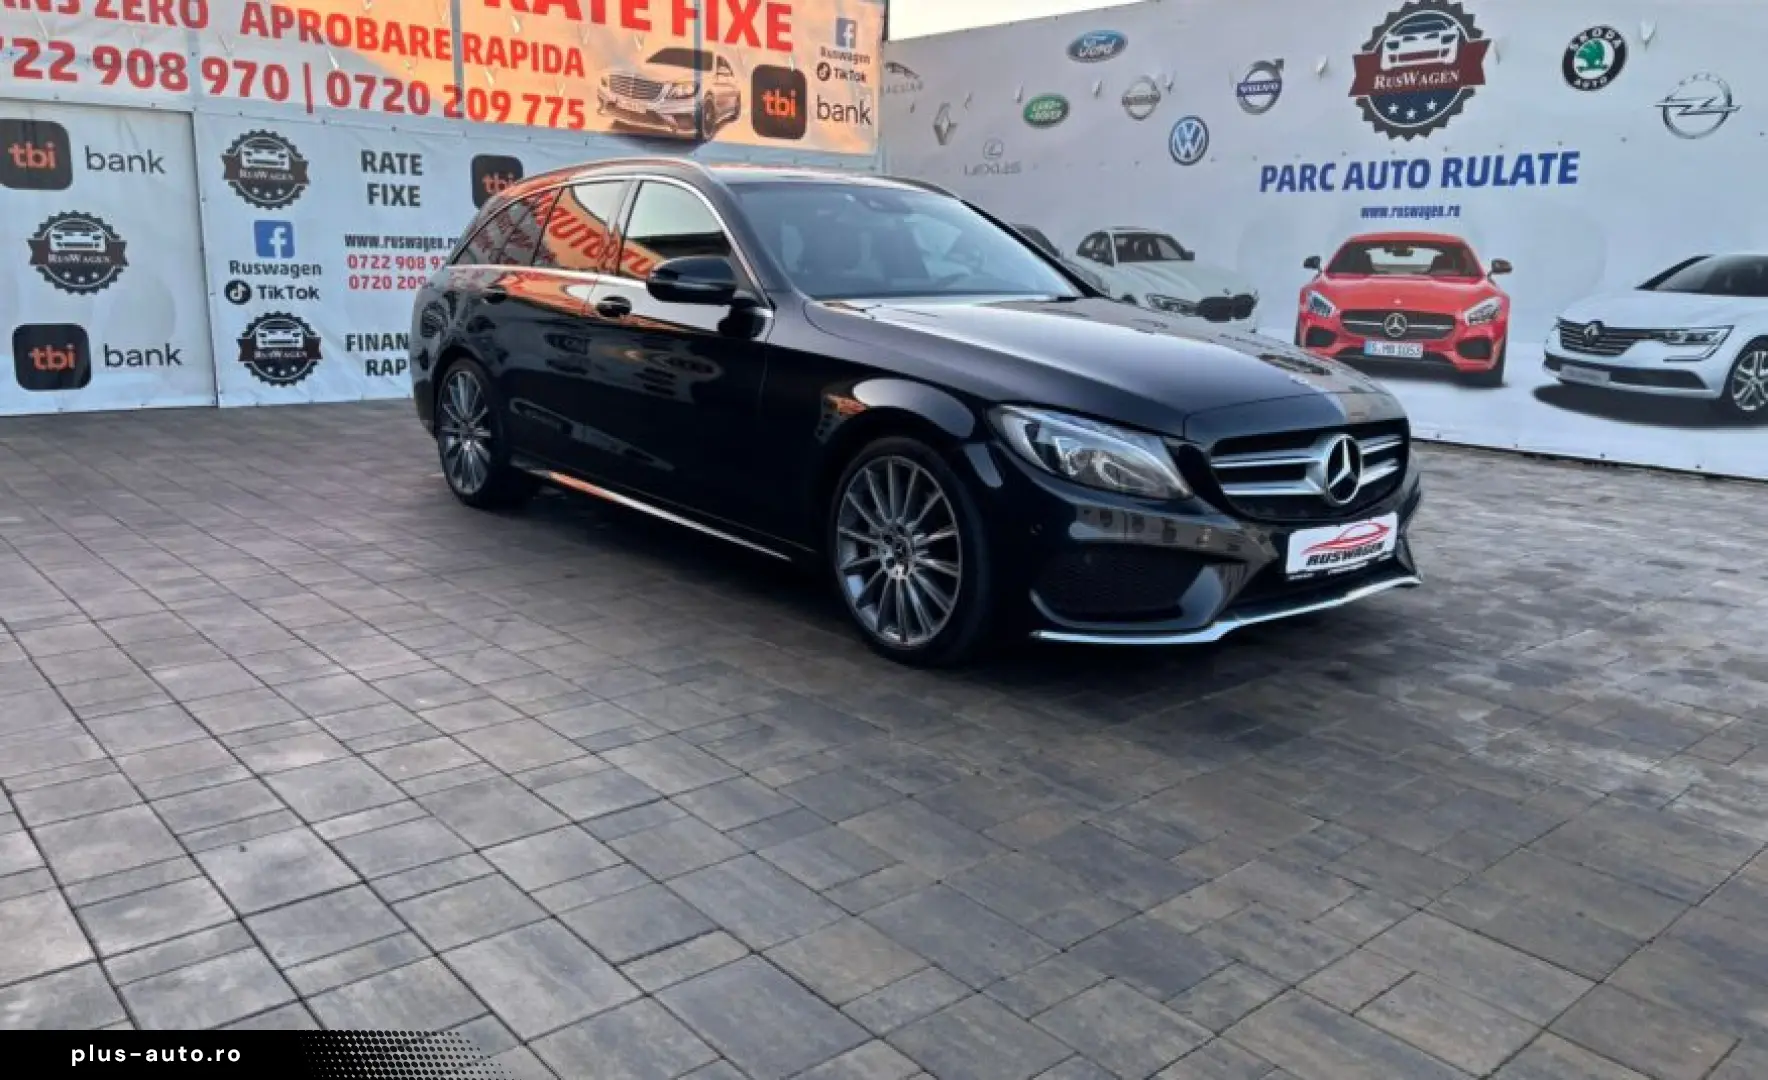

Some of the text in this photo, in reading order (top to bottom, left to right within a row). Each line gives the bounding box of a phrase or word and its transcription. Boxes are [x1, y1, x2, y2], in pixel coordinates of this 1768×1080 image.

[671, 0, 794, 52] FIXE
[240, 2, 452, 61] APROBARE
[462, 32, 586, 78] RAPIDA
[0, 36, 78, 82] 22
[92, 44, 189, 92] 908
[201, 56, 290, 102] 970
[326, 69, 430, 117] 0720
[443, 83, 511, 124] 209
[522, 92, 586, 131] 775
[833, 67, 867, 84] TikTok
[762, 88, 873, 126] tbi bank
[8, 141, 167, 174] tbi bank
[361, 149, 424, 176] RATE
[1260, 150, 1581, 193] PARC AUTO RULATE
[366, 182, 422, 208] FIXE
[1360, 204, 1461, 220] www.ruswagen.ro
[229, 260, 323, 279] Ruswagen
[347, 254, 391, 270] 0722
[395, 255, 427, 270] 908
[256, 285, 320, 300] TikTok
[348, 275, 393, 290] 0720
[29, 343, 183, 370] tbi bank
[365, 358, 408, 377] RAP
